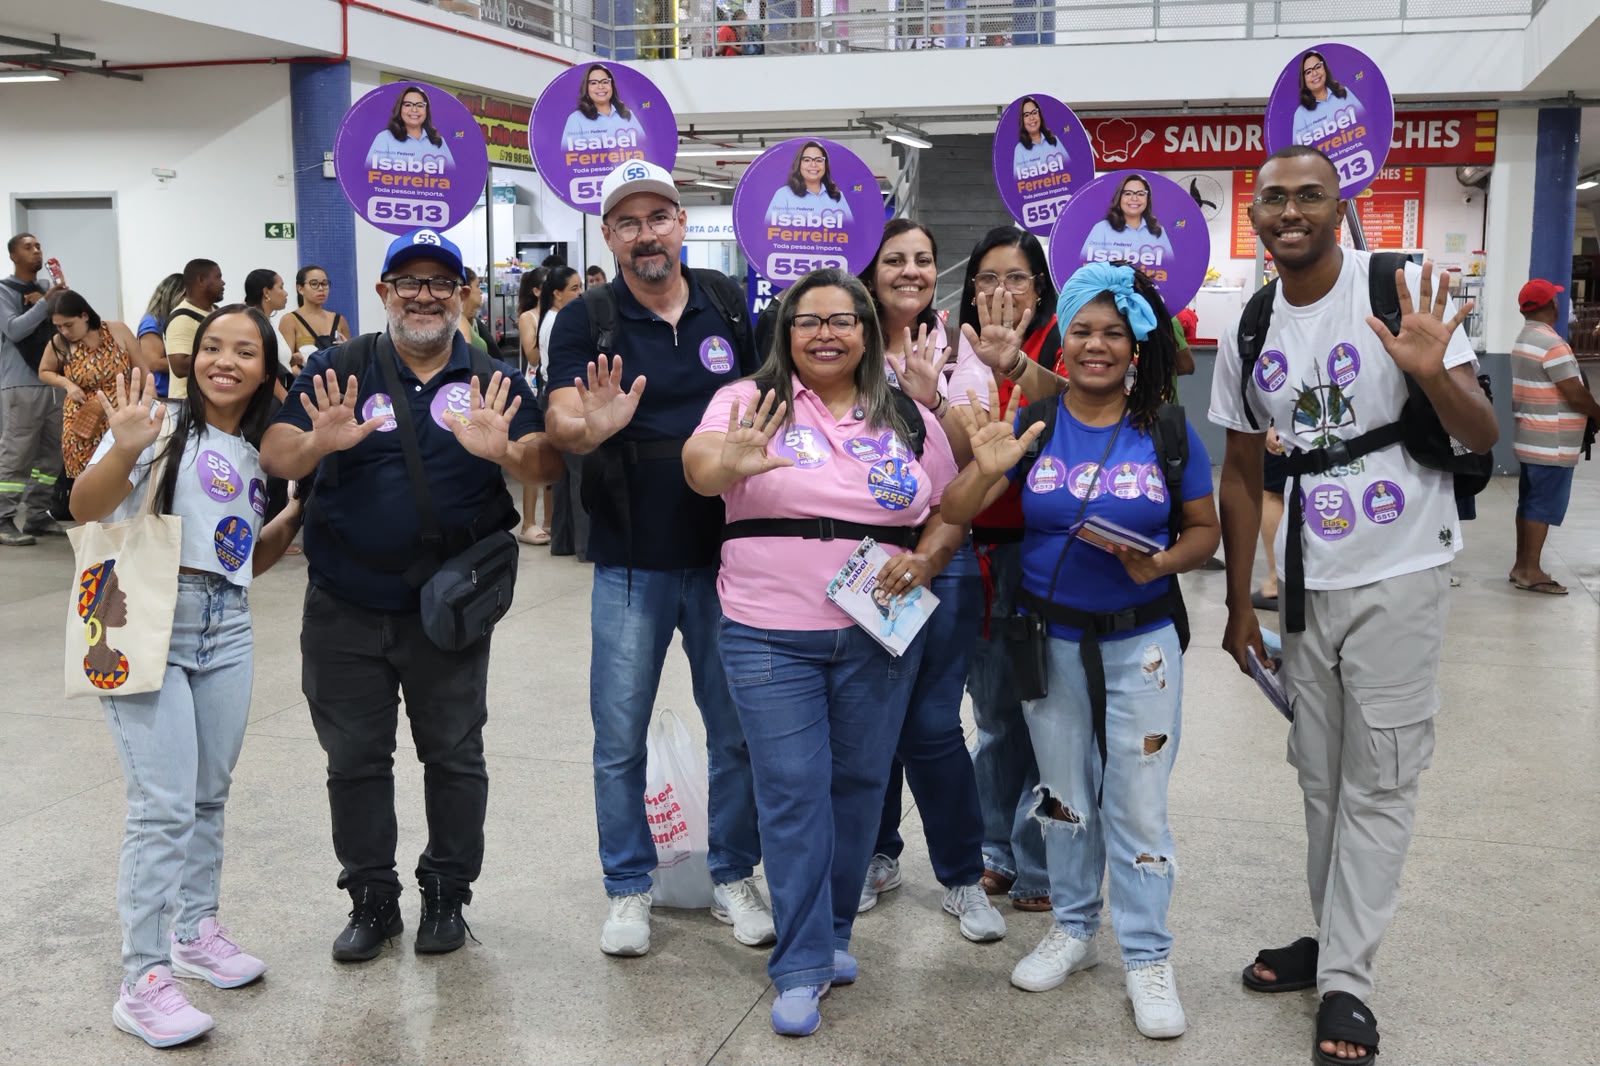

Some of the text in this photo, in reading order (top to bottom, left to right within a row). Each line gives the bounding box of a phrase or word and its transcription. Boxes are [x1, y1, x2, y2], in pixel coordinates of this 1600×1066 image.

[480, 0, 525, 28] MAOS
[1164, 120, 1461, 153] SANDR CHES
[1296, 106, 1357, 146] Isabel
[567, 130, 637, 151] Isabel
[1317, 125, 1367, 152] rreira
[372, 155, 444, 174] Isabel
[565, 148, 645, 166] Ferreira
[1016, 155, 1064, 180] Isabel
[627, 168, 645, 180] 55
[1339, 157, 1368, 180] 13
[368, 170, 451, 189] Ferreira
[1017, 172, 1071, 193] Ferreira
[391, 188, 416, 196] pessoa
[375, 202, 442, 222] 5513
[771, 210, 843, 228] Isabel
[419, 234, 436, 245] 55
[768, 228, 849, 243] Ferreira
[1086, 247, 1163, 266] Isabel
[207, 453, 231, 476] 55
[874, 489, 910, 507] 55555
[1314, 490, 1343, 511] 55
[217, 547, 240, 569] 55555
[846, 559, 868, 588] Isabel
